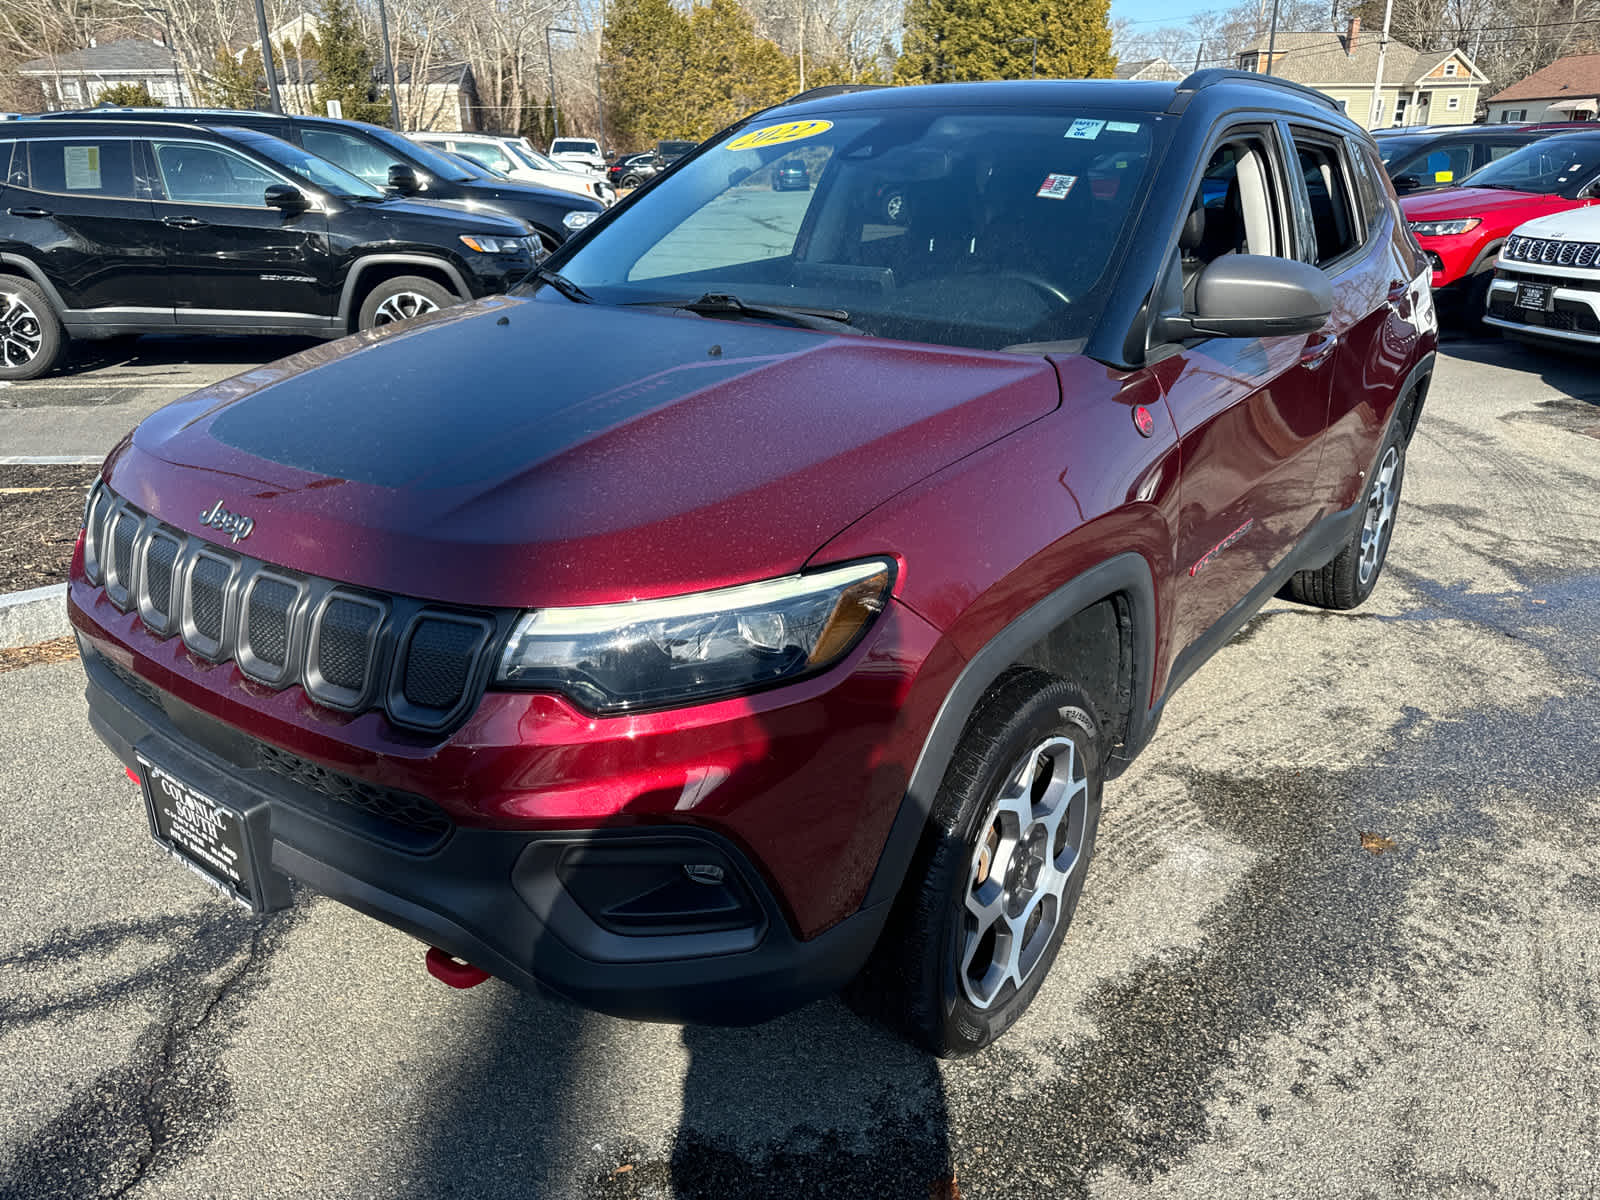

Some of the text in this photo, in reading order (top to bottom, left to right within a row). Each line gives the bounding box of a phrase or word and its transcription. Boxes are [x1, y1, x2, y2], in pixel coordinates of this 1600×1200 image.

[728, 121, 823, 149] 2022
[199, 499, 255, 544] Jeep
[161, 778, 227, 831] COLONIAL
[175, 801, 219, 840] SOUTH
[163, 808, 216, 846] CHRYSLER
[172, 821, 206, 847] DODGE
